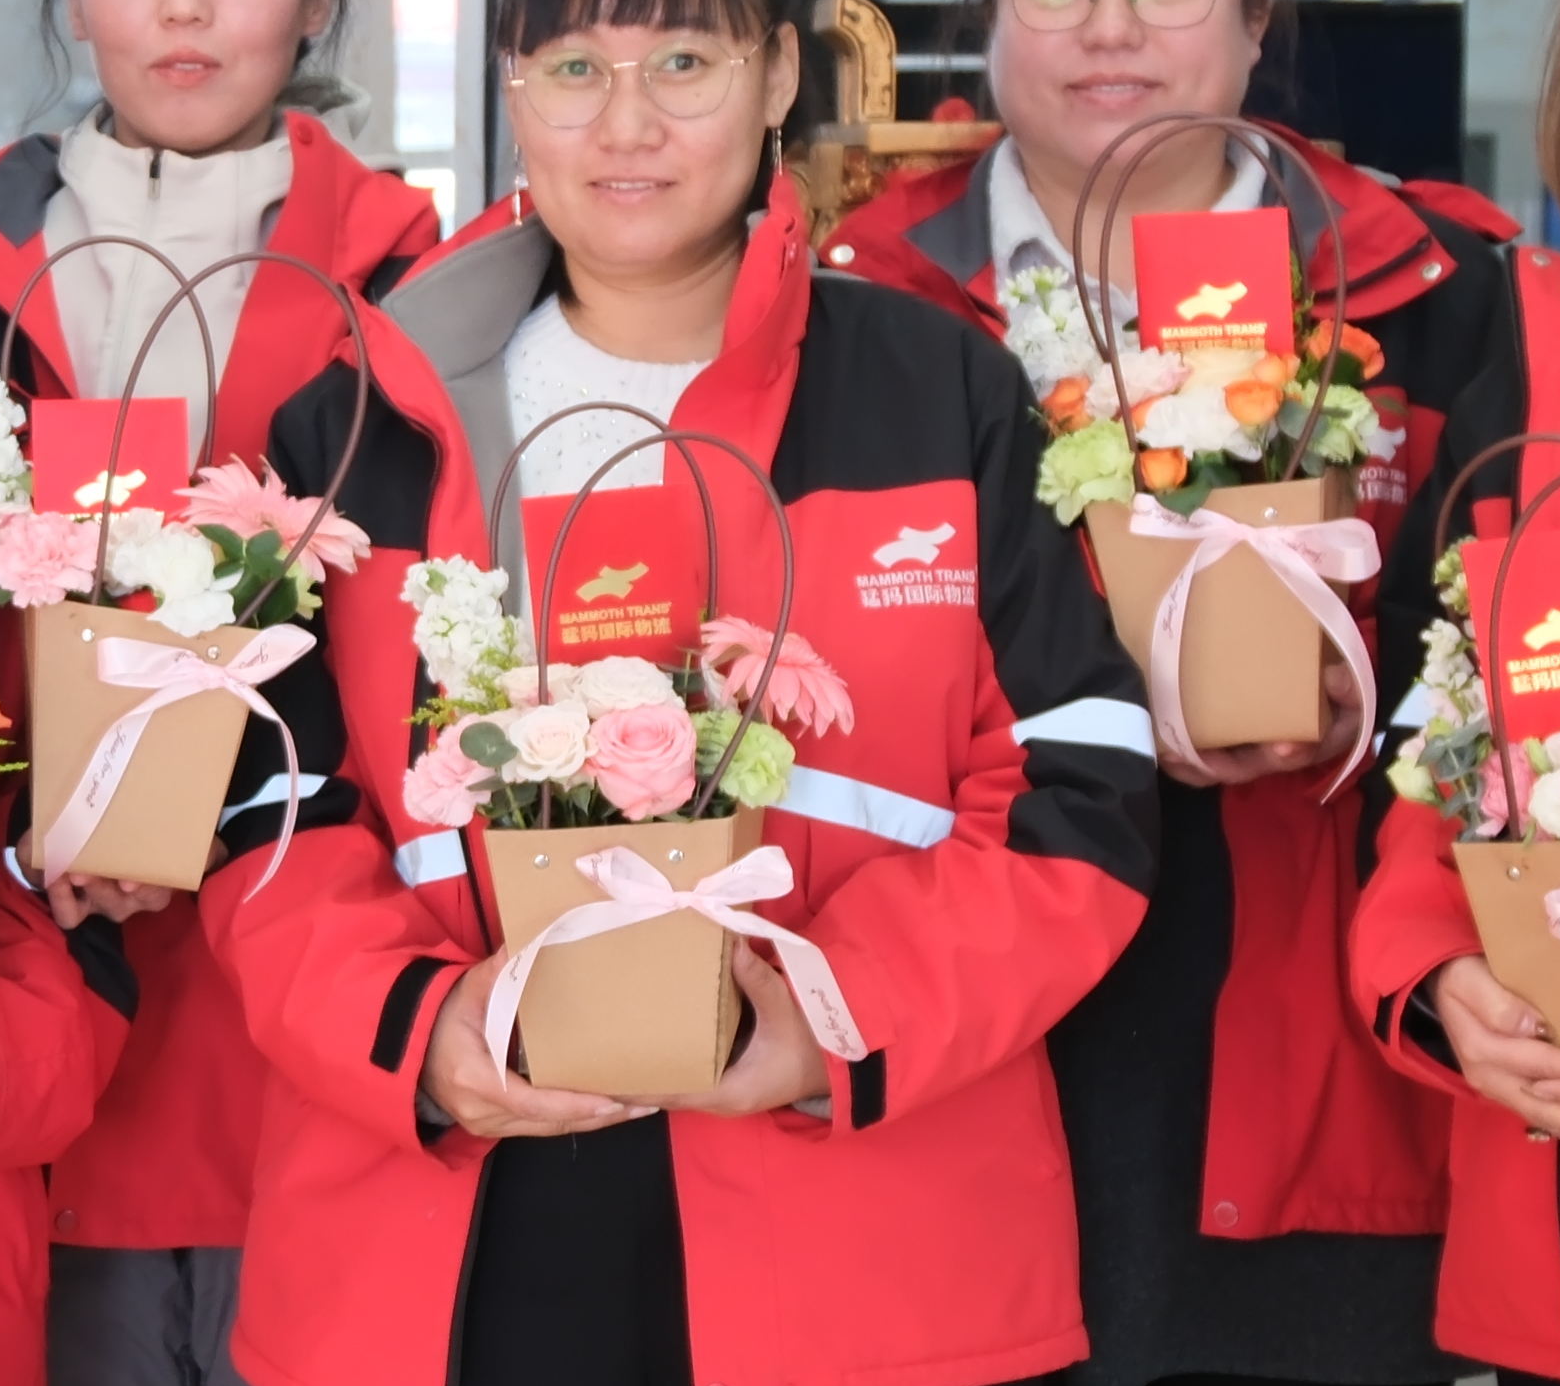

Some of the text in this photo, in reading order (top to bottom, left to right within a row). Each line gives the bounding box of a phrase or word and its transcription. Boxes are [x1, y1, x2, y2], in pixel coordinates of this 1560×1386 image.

[1161, 324, 1223, 339] MAMMOTH
[855, 569, 933, 587] MAMMOTH
[861, 583, 976, 608] 猛犸国际物流
[559, 607, 625, 625] MAMMOTH
[561, 617, 673, 645] 猛犸国际物流
